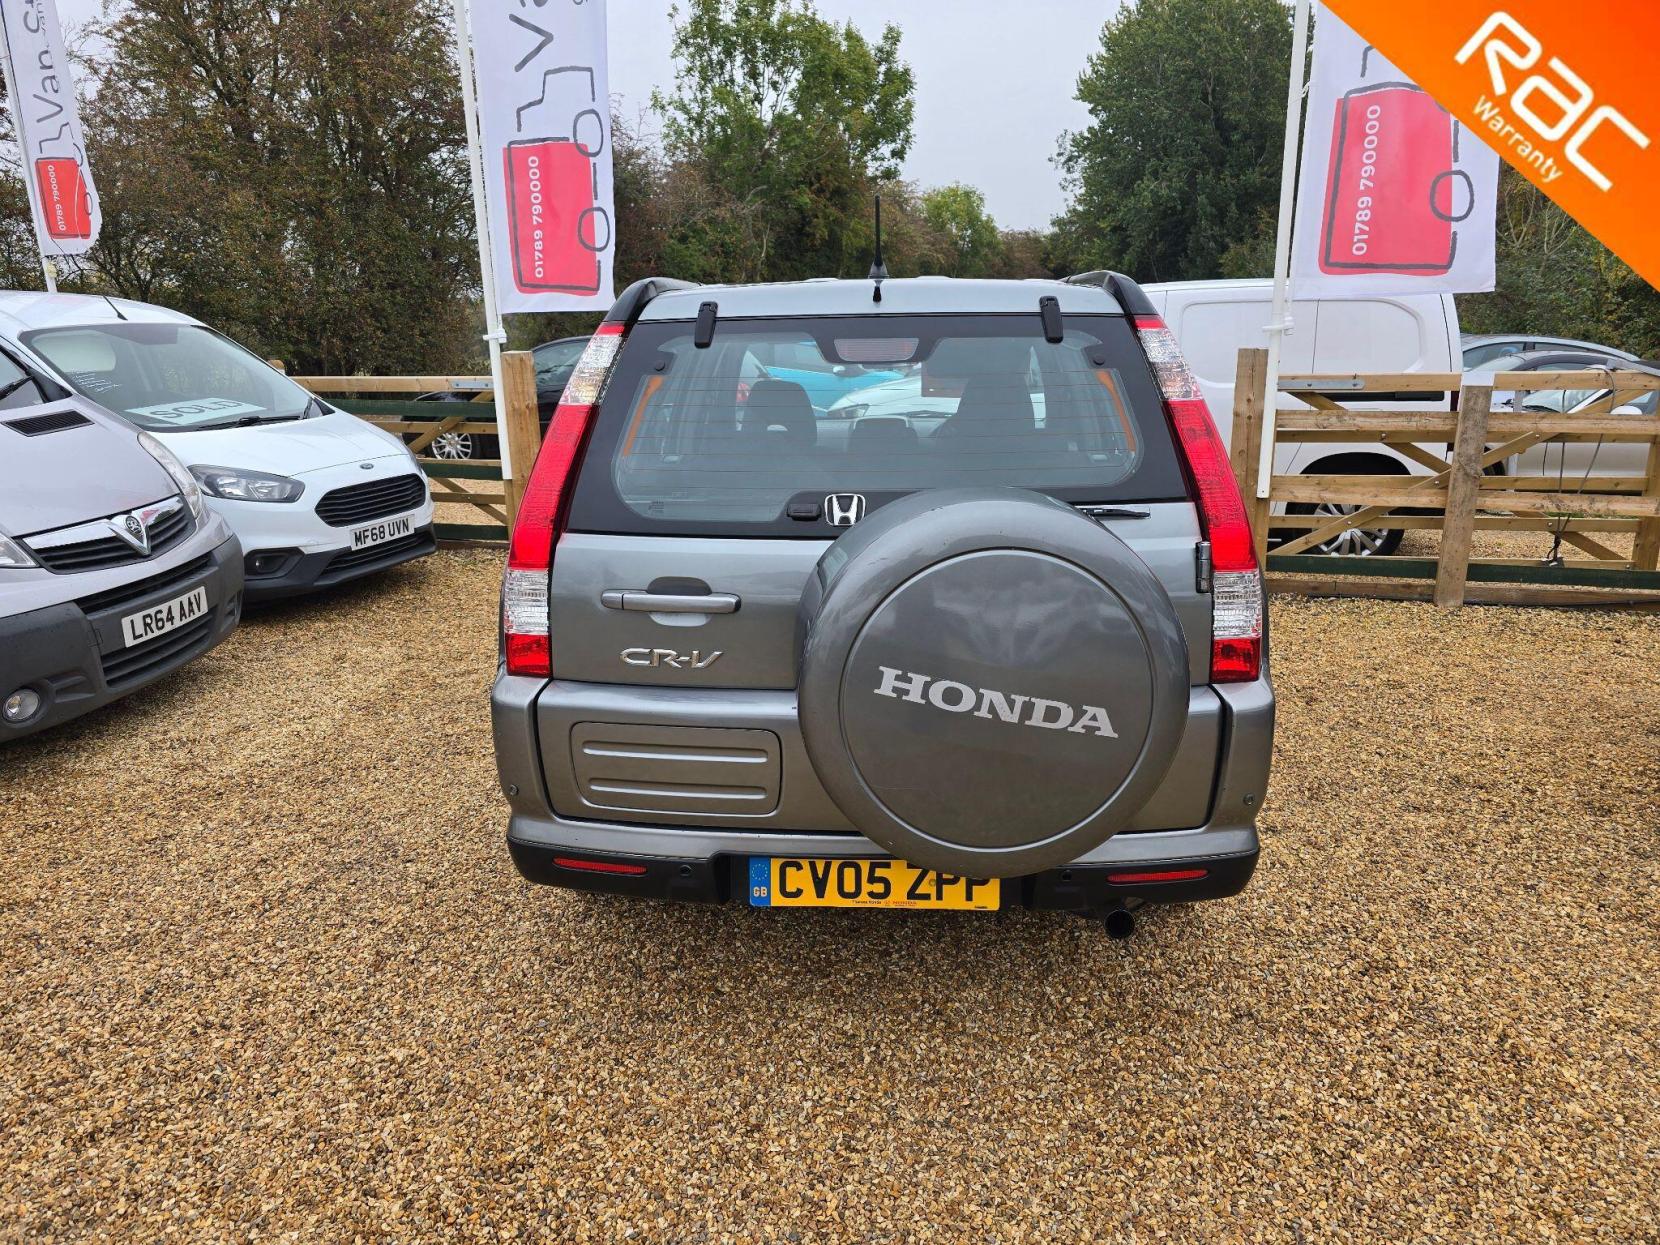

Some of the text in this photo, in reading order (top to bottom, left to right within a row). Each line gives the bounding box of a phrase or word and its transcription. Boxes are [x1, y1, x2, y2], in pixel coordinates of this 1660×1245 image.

[23, 0, 40, 34] C
[33, 50, 63, 123] Van
[48, 165, 66, 231] 01789 790000
[1352, 105, 1381, 256] 01789 790000
[528, 156, 544, 278] 01789 790000
[150, 400, 243, 419] SOLD
[354, 518, 410, 547] MF68 UVN
[130, 592, 202, 641] LR64 AAV
[619, 647, 724, 669] CR-V
[873, 665, 1119, 739] HONDA
[753, 887, 768, 898] GB
[779, 860, 991, 902] CV05 ZPP
